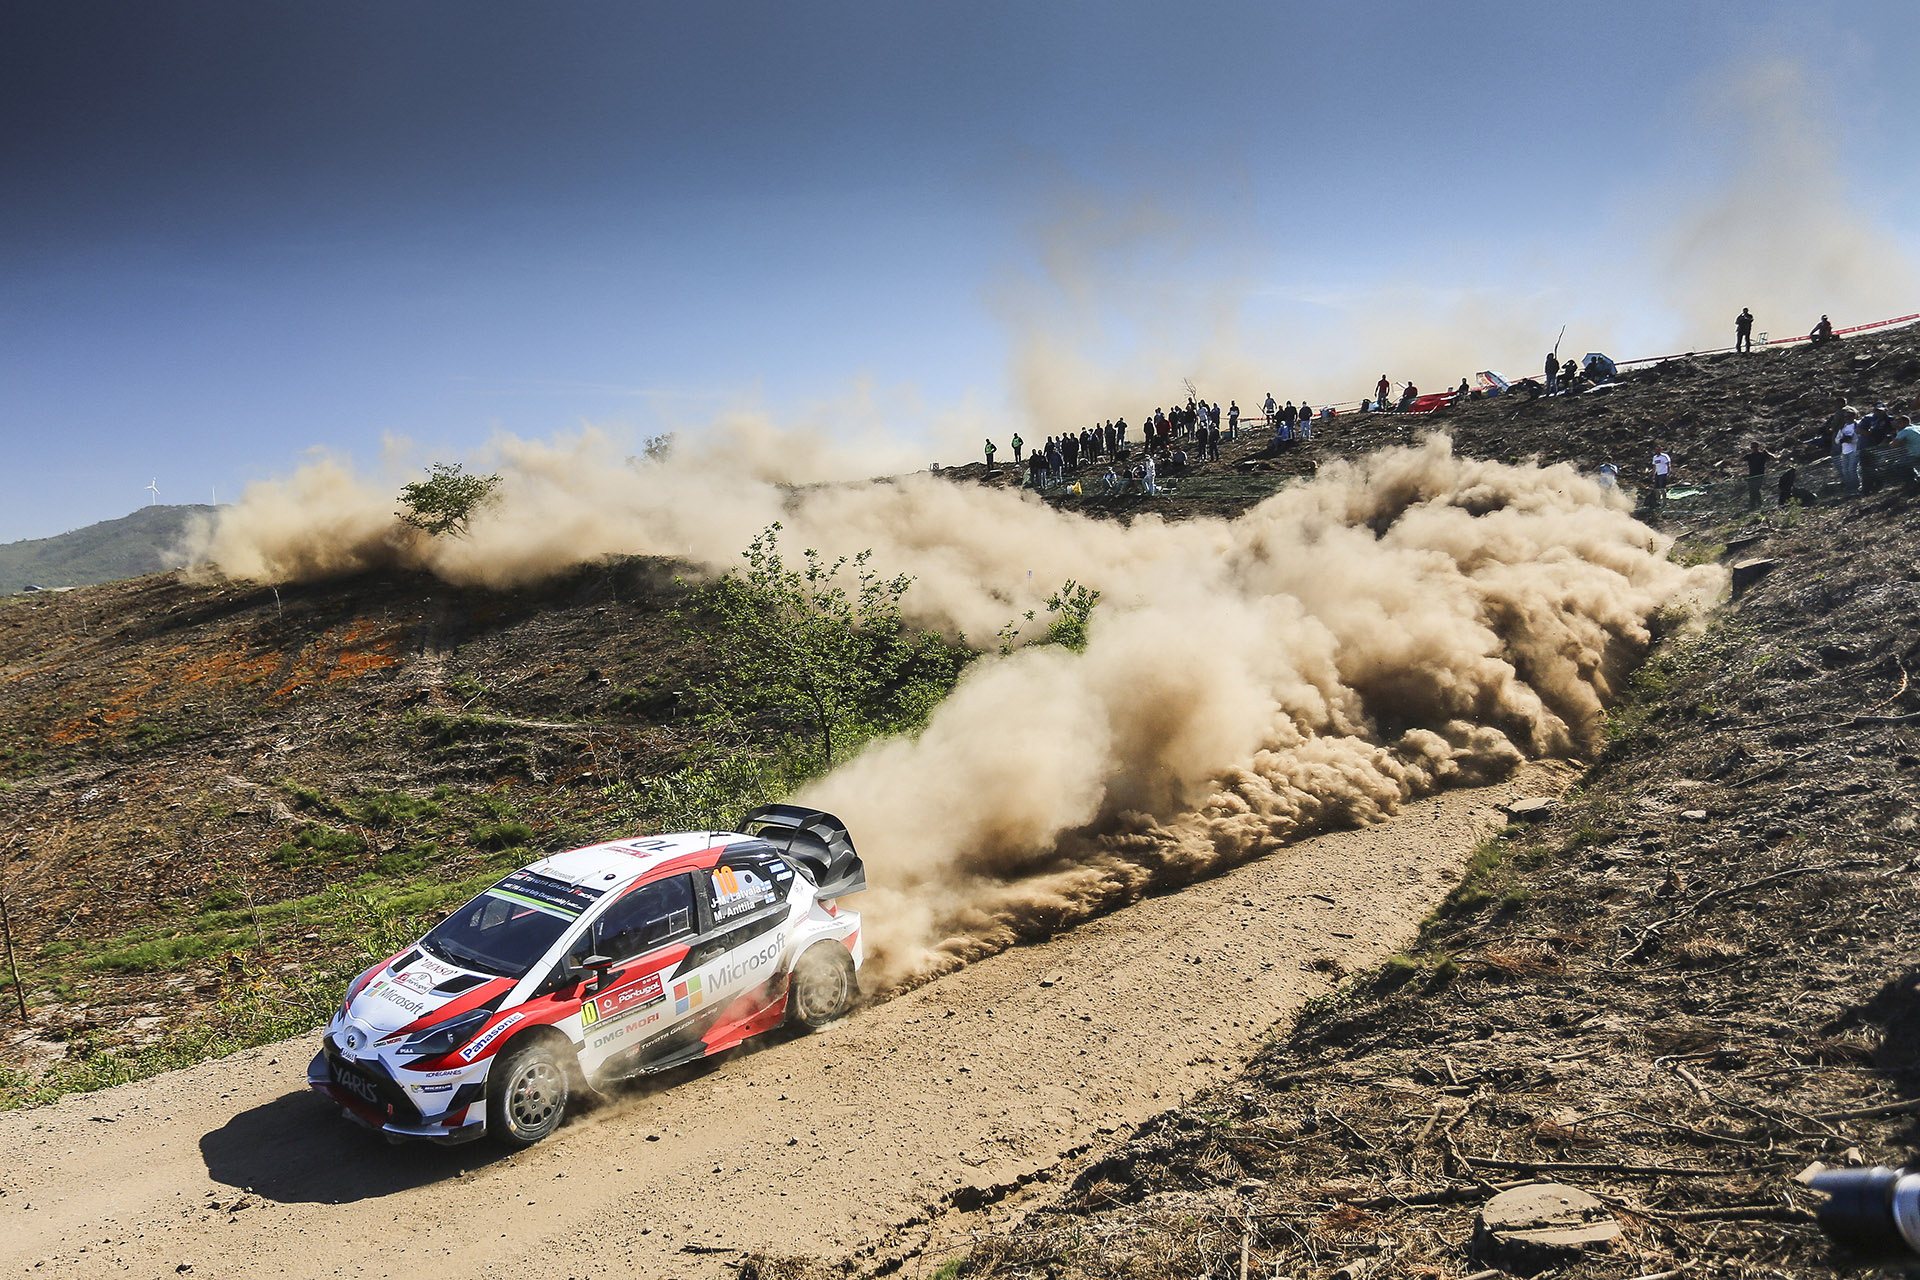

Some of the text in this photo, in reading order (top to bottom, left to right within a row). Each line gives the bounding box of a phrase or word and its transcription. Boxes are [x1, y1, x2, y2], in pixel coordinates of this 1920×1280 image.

[712, 865, 739, 896] 10
[729, 885, 762, 901] Latvala
[713, 901, 756, 922] M. Anttila
[421, 960, 454, 976] DENSO
[707, 932, 787, 993] Microsoft
[378, 987, 424, 1015] Microsoft
[618, 981, 660, 1004] Portugal
[581, 1002, 598, 1027] 10
[462, 1013, 522, 1059] Panasonic
[593, 1012, 660, 1048] DMG MORI
[641, 1032, 669, 1050] TOYOTA
